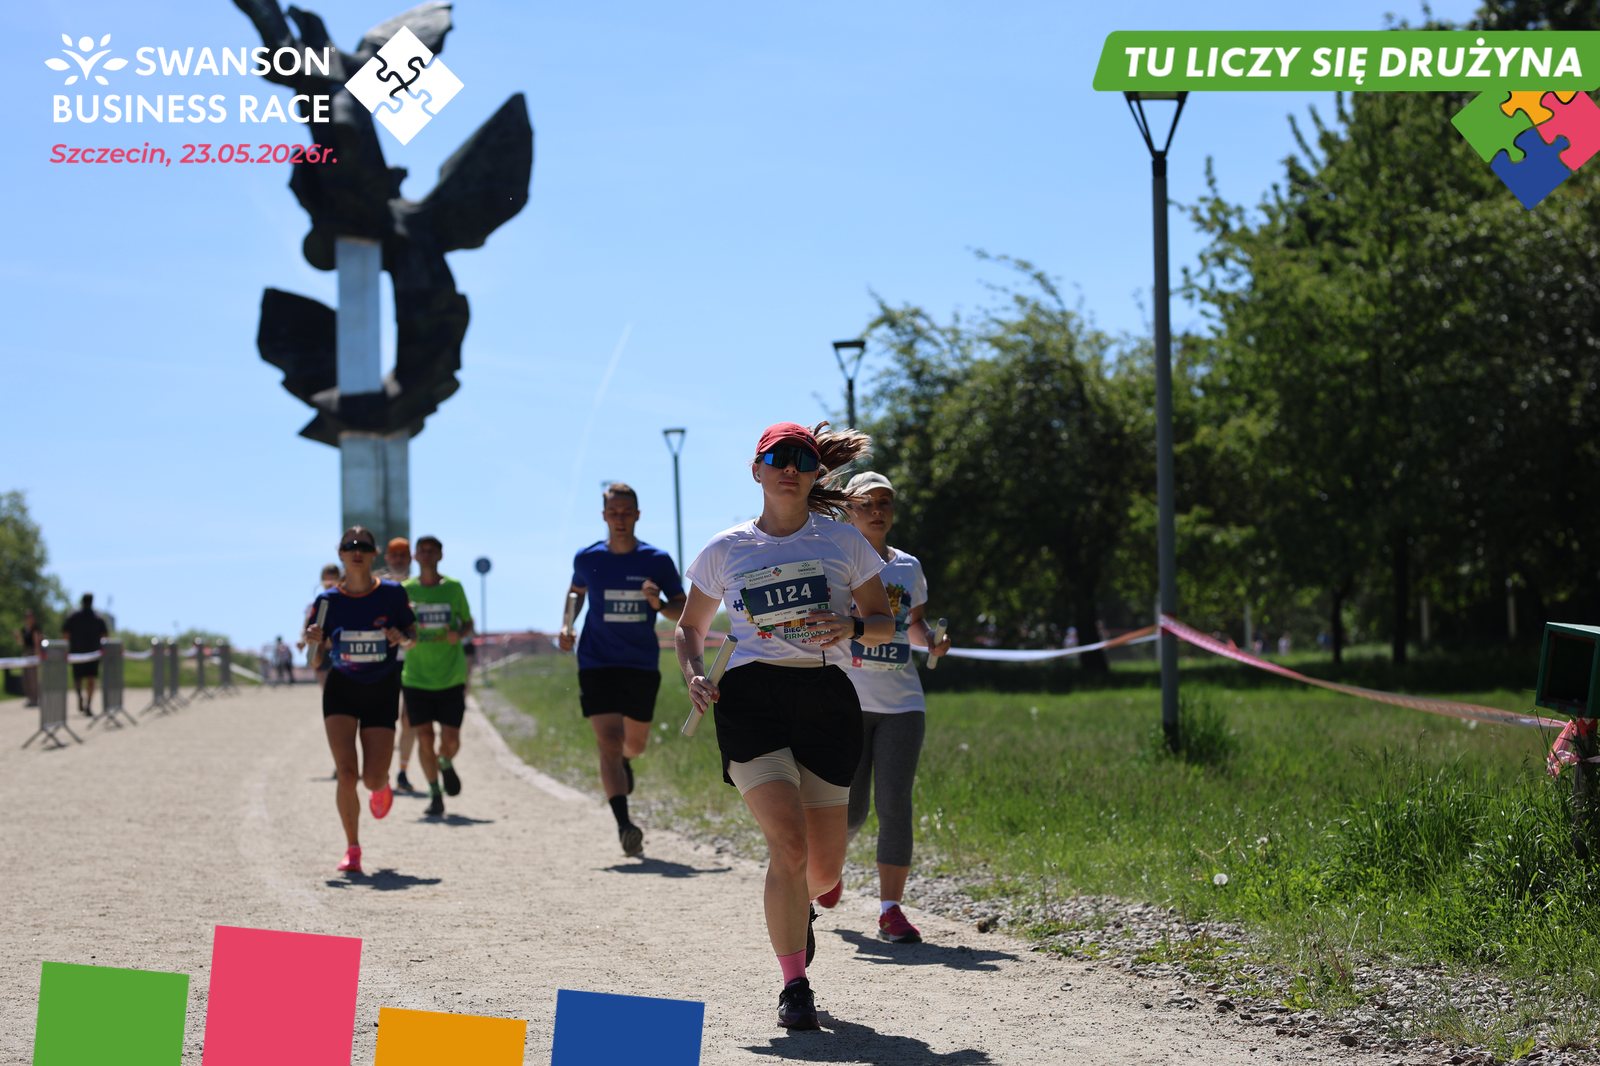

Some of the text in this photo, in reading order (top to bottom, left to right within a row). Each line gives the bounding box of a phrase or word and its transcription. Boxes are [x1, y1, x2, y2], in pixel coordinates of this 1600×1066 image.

[765, 583, 812, 607] 1124
[613, 602, 639, 613] 1271
[349, 642, 377, 653] 1071
[862, 645, 898, 660] 1012
